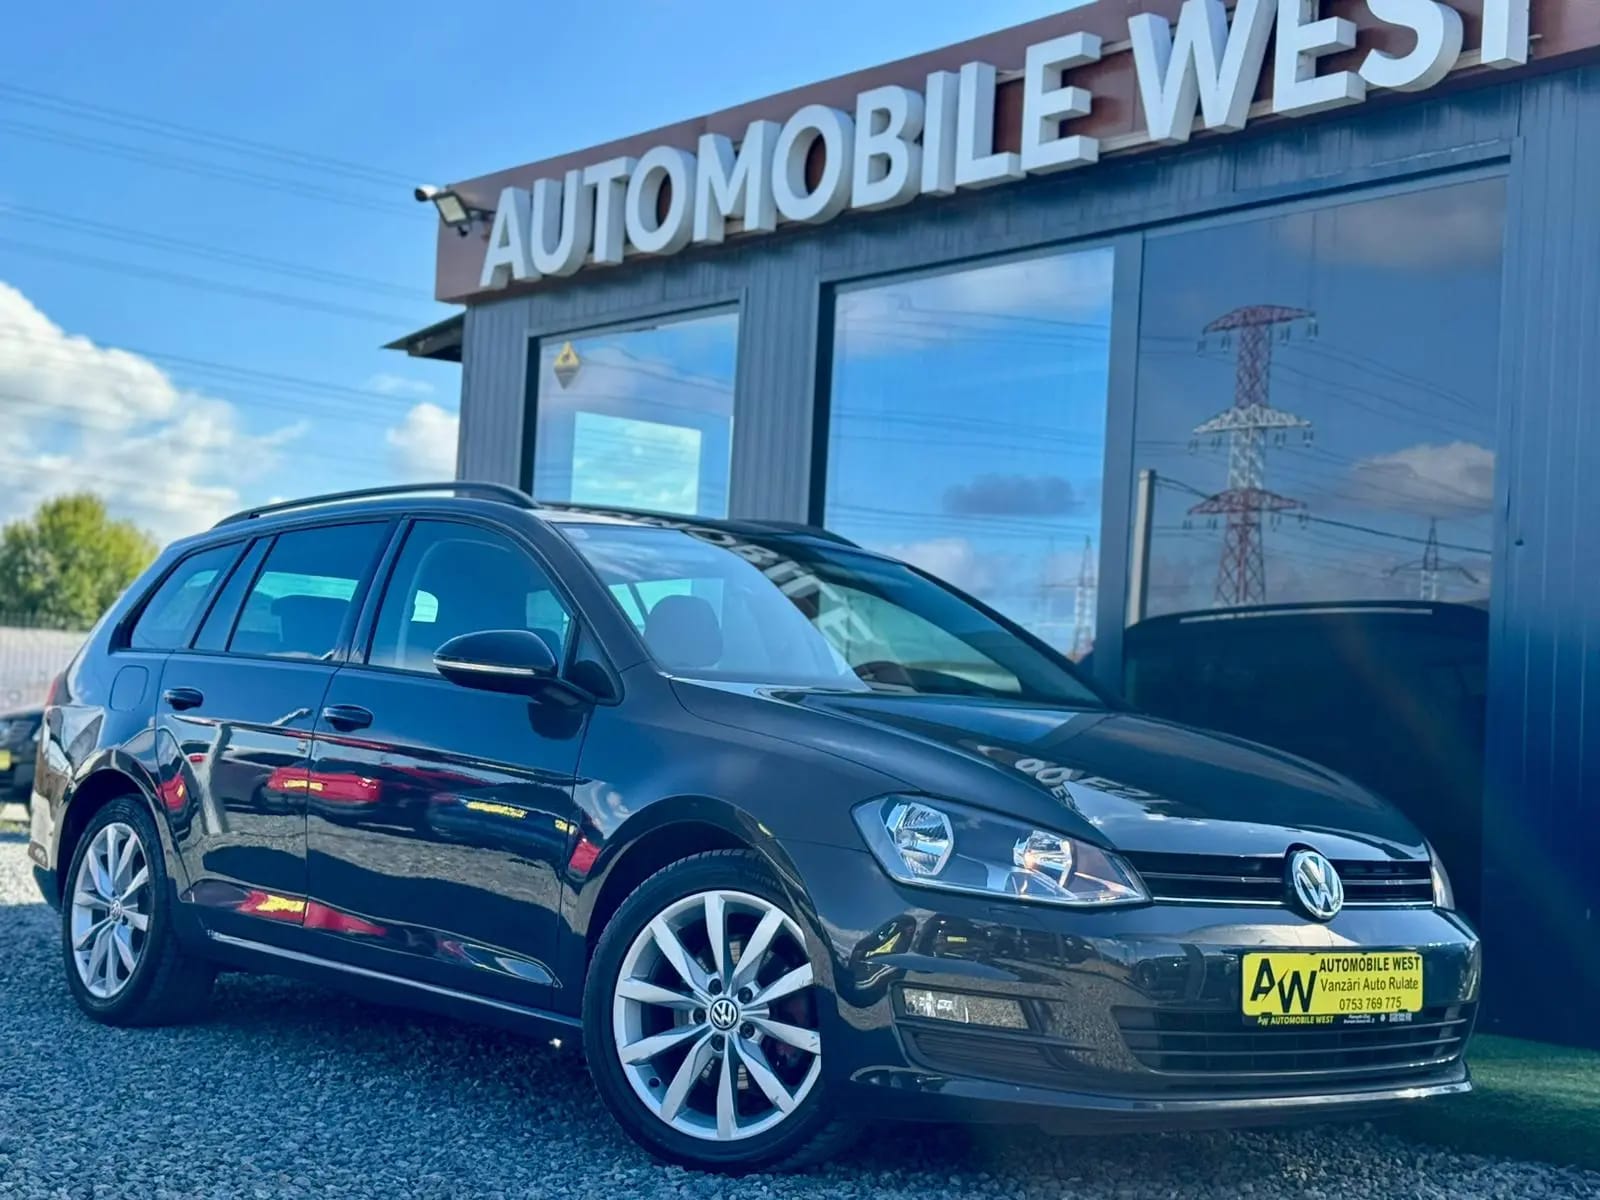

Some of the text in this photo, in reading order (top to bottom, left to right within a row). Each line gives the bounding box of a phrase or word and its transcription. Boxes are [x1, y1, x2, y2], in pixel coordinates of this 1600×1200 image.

[480, 31, 1102, 289] AUTOMOBILE
[1319, 956, 1421, 973] AUTOMOBILE WEST
[1363, 977, 1386, 991] Auto
[1388, 976, 1419, 990] Rulate
[1339, 996, 1402, 1011] 0753 769 775
[1271, 1015, 1315, 1025] AUTOMOBILE
[1315, 1015, 1334, 1024] WEST
